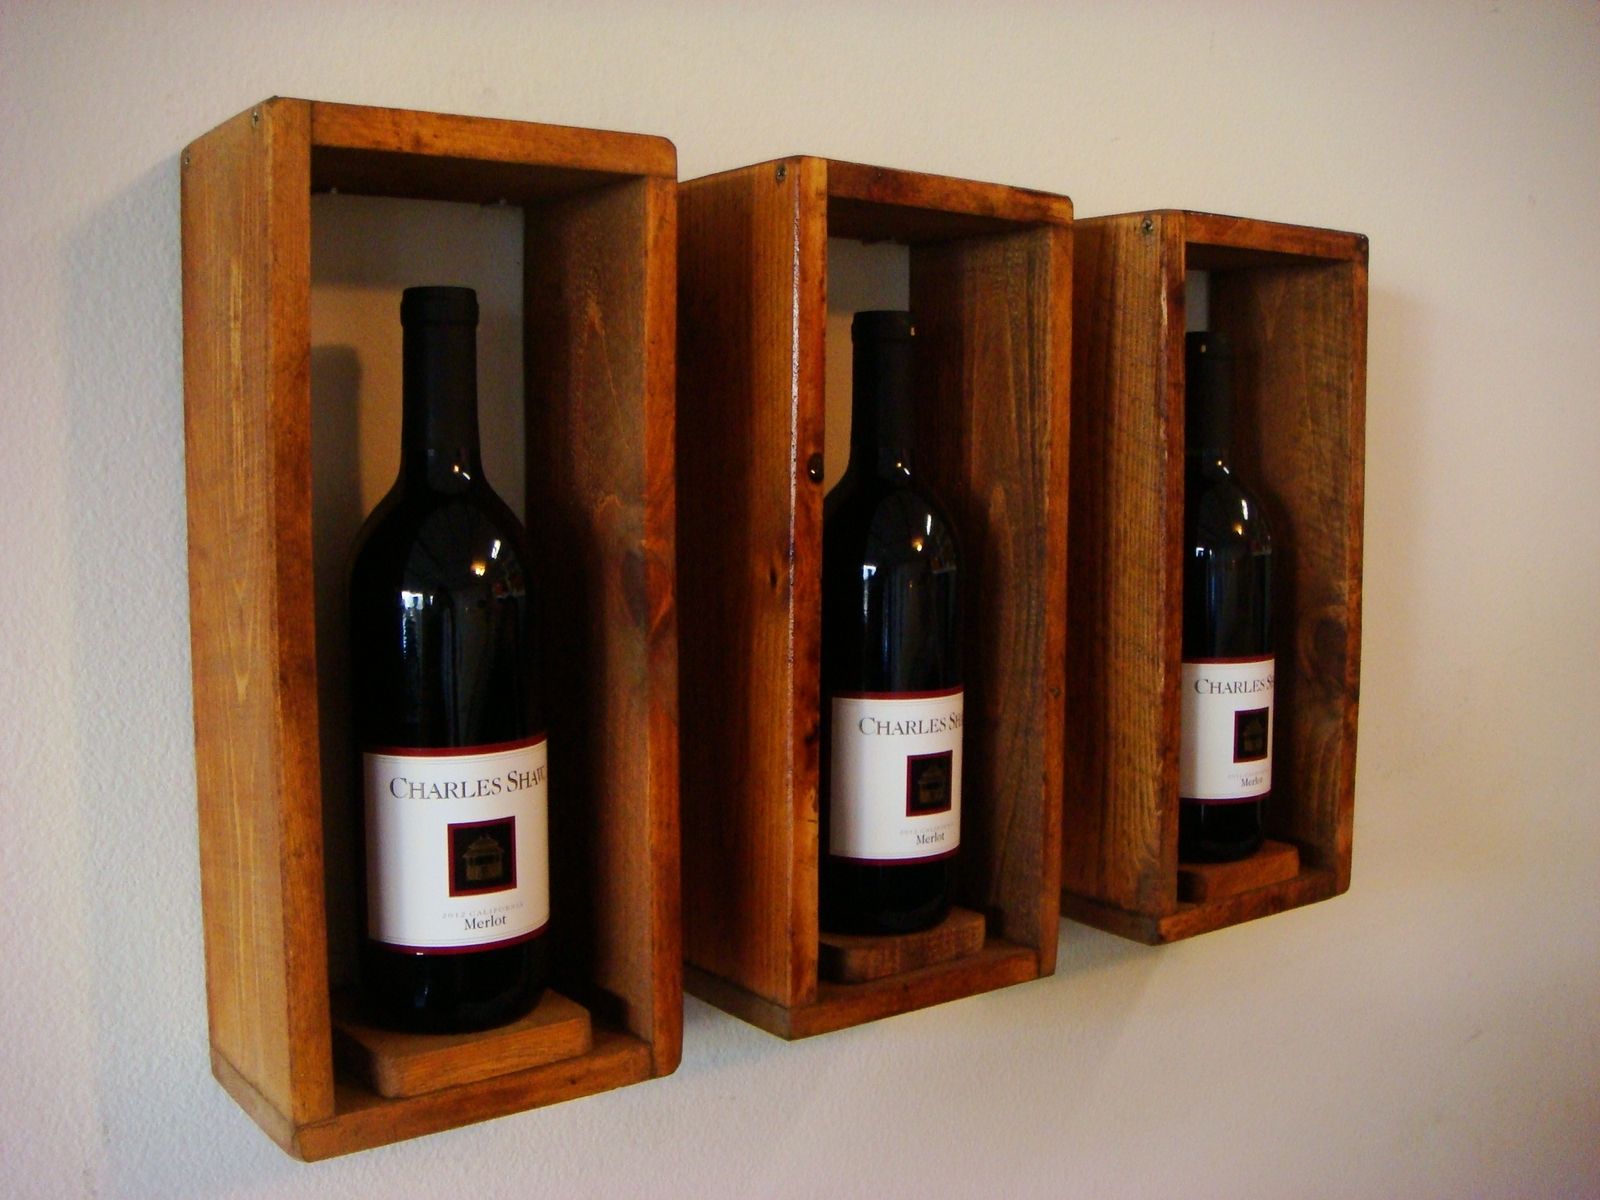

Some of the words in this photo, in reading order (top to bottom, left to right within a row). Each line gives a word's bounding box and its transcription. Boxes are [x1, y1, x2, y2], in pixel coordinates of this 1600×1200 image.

[1194, 678, 1265, 694] CHARLES
[859, 717, 946, 736] CHARLES
[389, 776, 502, 800] CHARLES
[464, 915, 507, 931] Merlot
